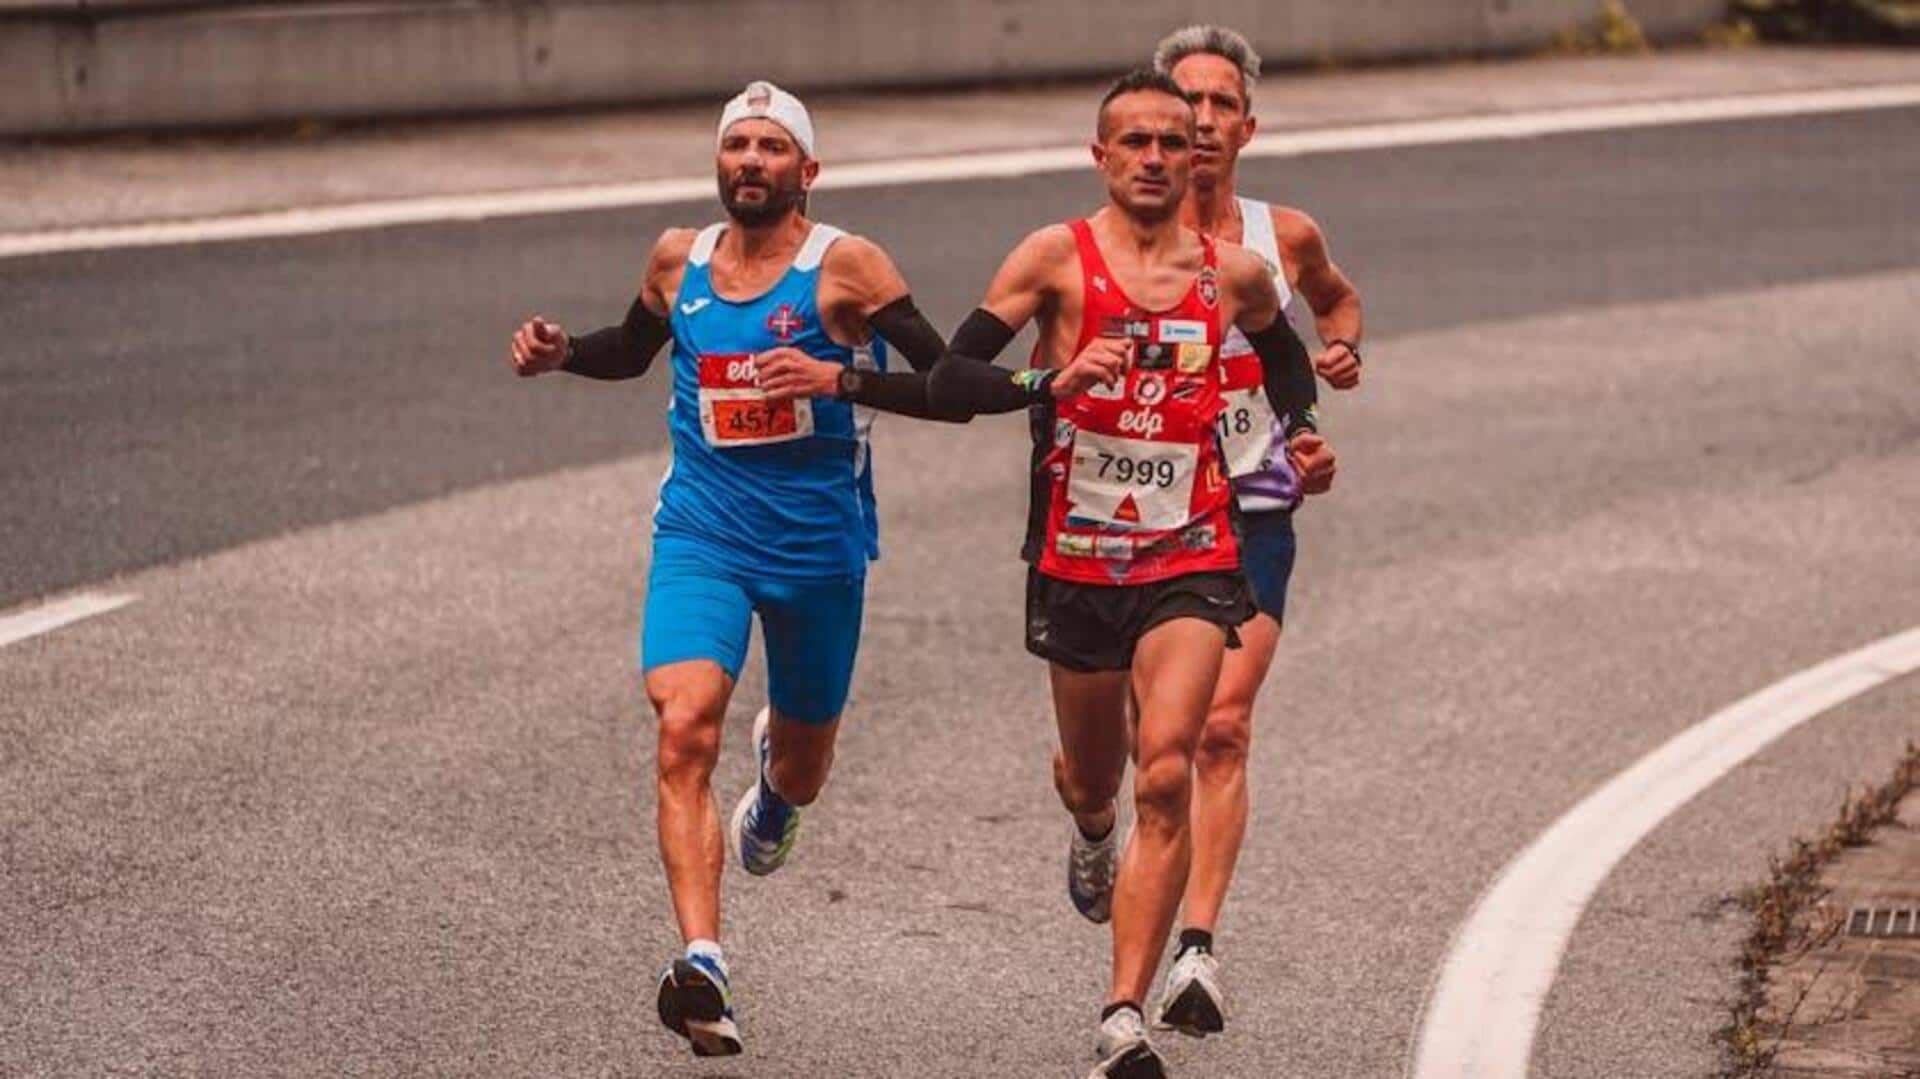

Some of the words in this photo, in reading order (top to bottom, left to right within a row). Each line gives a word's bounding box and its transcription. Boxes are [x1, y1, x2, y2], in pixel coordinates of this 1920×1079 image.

[731, 408, 777, 433] 457
[1118, 407, 1163, 438] edp
[1097, 453, 1175, 488] 7999
